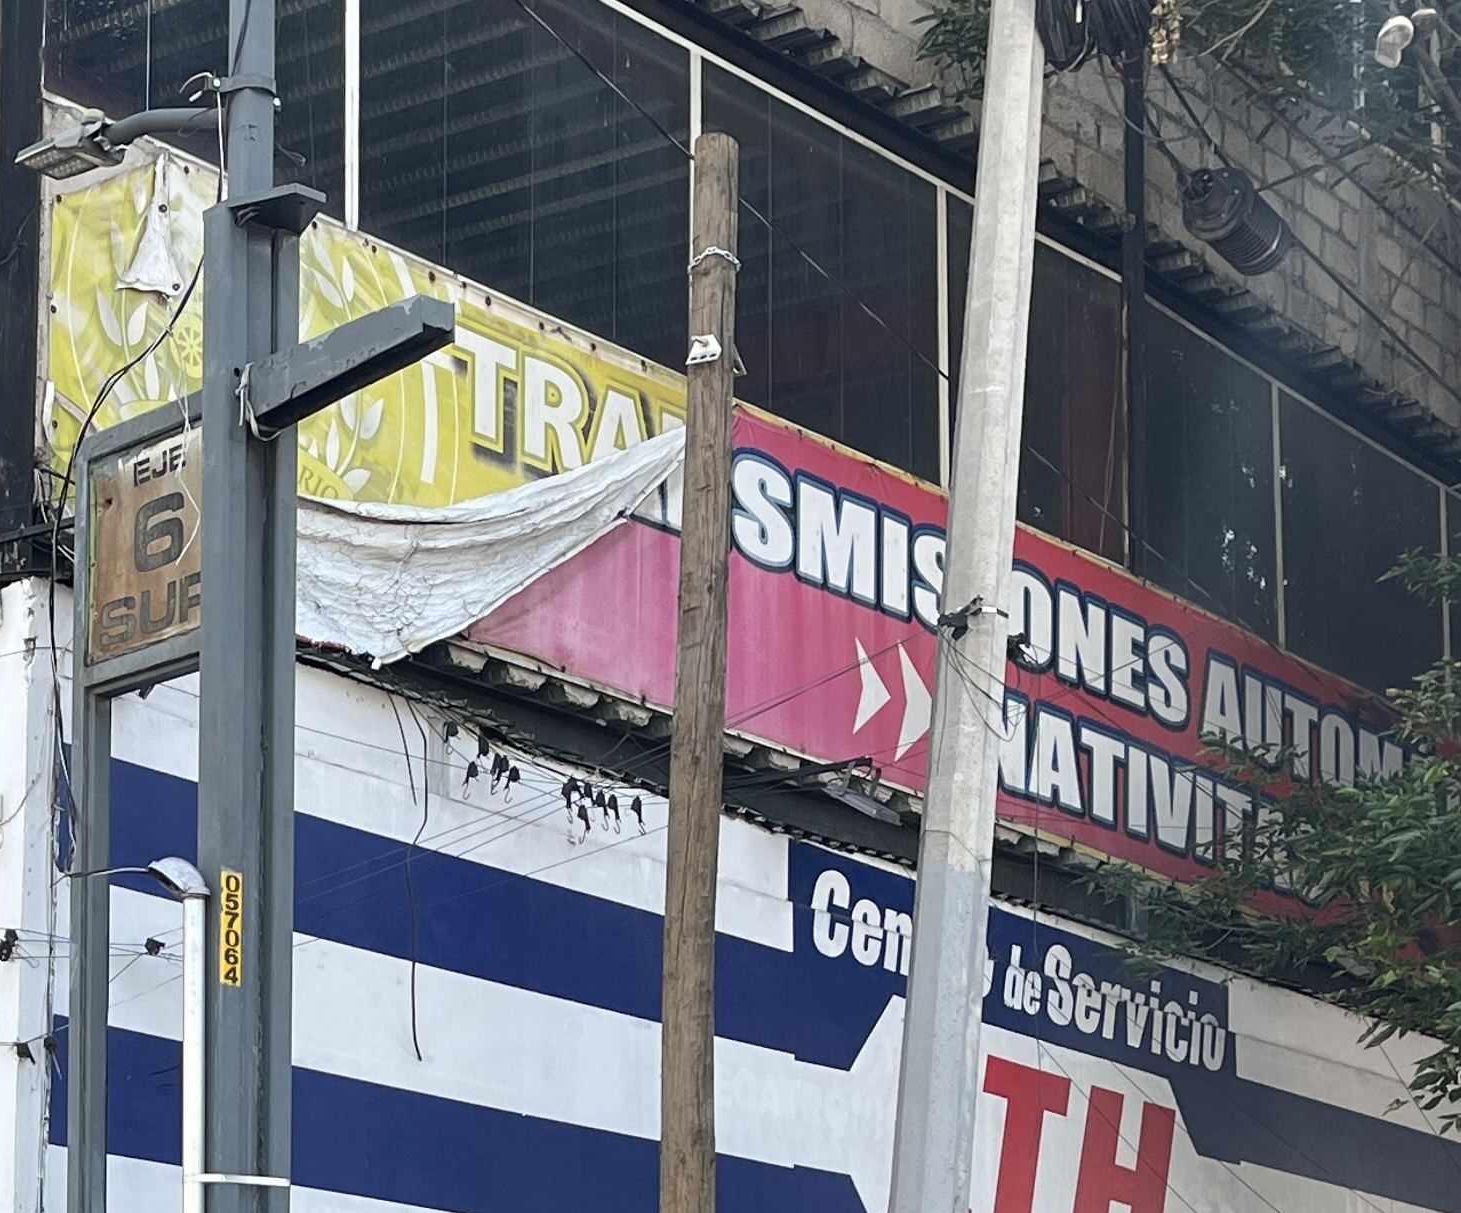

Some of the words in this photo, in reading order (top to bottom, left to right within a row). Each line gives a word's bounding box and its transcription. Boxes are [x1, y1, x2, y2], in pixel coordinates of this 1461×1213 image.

[133, 443, 187, 487] EJE
[134, 491, 185, 573] 6
[225, 875, 240, 984] 057064
[1003, 944, 1042, 1016] de
[1043, 943, 1227, 1073] Servicio
